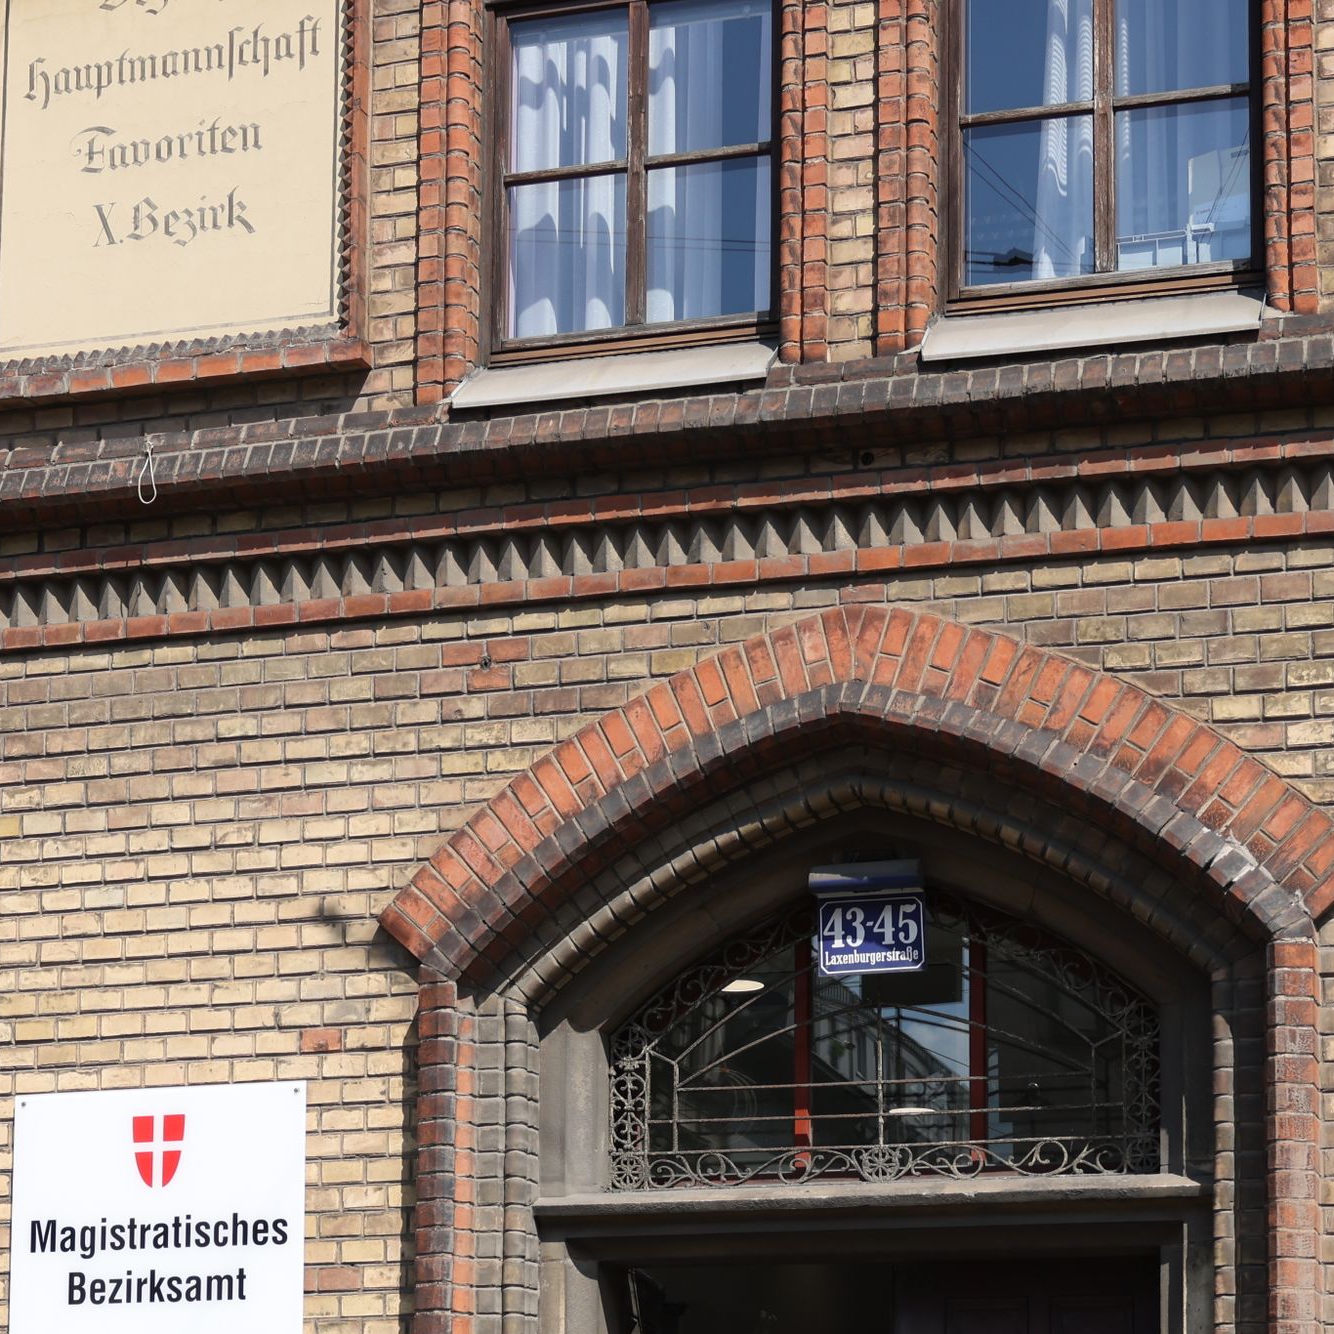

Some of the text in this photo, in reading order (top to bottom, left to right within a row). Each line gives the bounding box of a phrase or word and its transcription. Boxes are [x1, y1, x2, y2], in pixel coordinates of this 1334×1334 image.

[67, 116, 263, 174] Favoriten
[823, 904, 918, 948] 43-45
[825, 945, 919, 966] Laxenburgerstraße
[30, 1212, 289, 1260] Magistratisches
[67, 1267, 247, 1306] Bezirksamt
